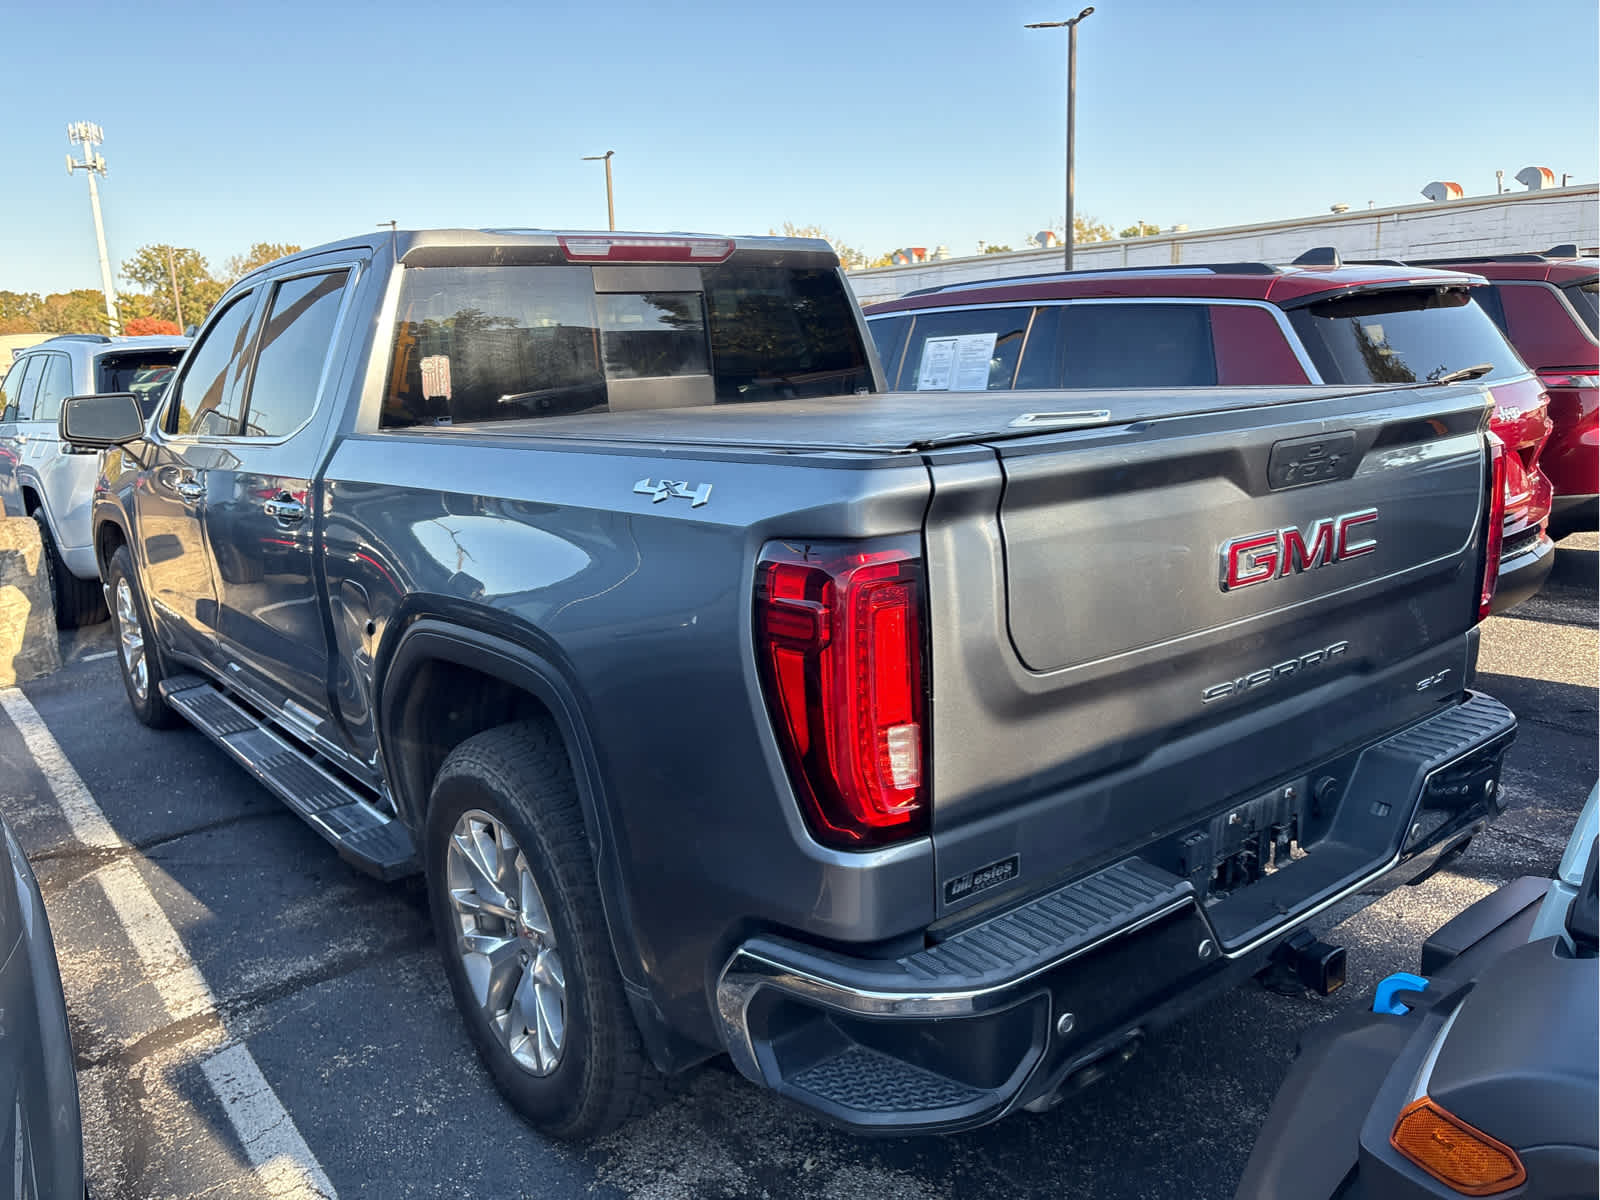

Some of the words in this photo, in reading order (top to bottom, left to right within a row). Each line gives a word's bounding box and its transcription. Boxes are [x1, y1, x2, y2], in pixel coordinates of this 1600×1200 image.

[1219, 507, 1379, 593] GMC
[1201, 640, 1349, 704] SIERRA
[1416, 668, 1451, 691] SLT
